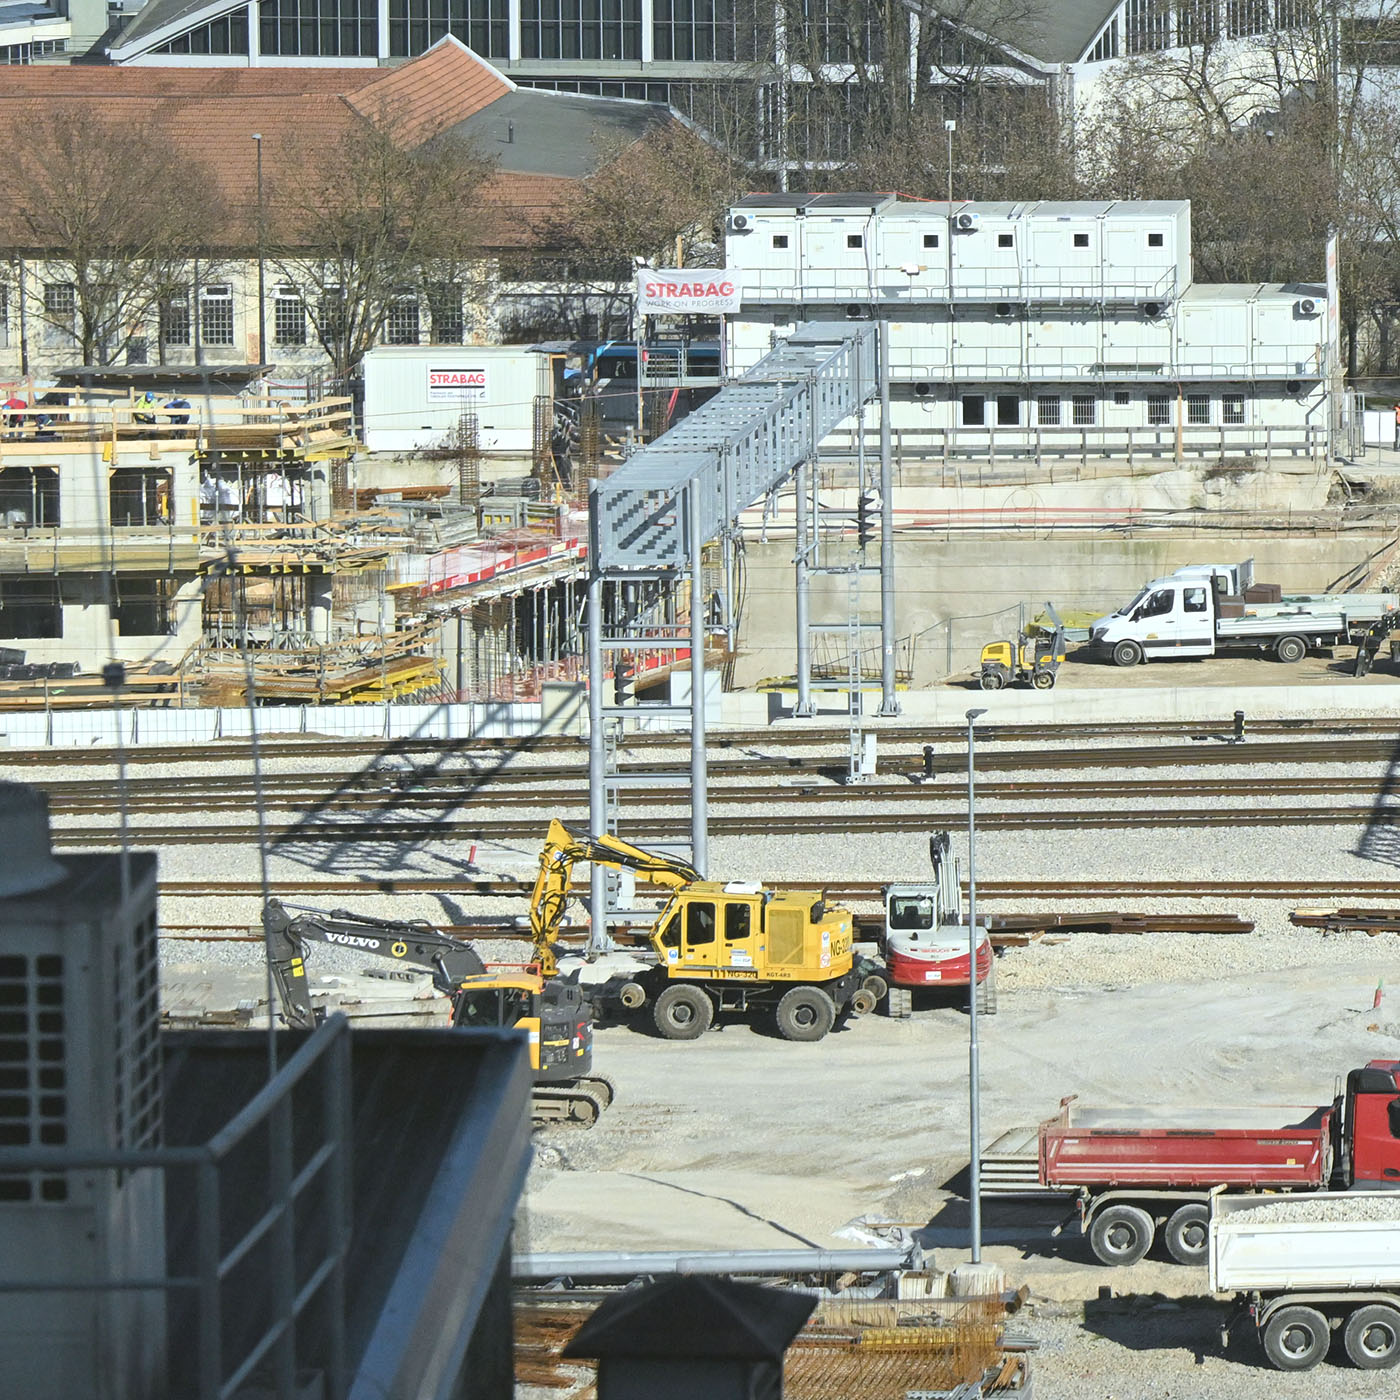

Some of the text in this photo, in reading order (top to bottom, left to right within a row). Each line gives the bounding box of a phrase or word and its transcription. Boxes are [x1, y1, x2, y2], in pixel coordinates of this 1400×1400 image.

[645, 281, 735, 298] STRABAG
[646, 298, 733, 307] WORK ON PROGRESS
[430, 374, 486, 384] STRABAG
[325, 932, 380, 949] VOLVO
